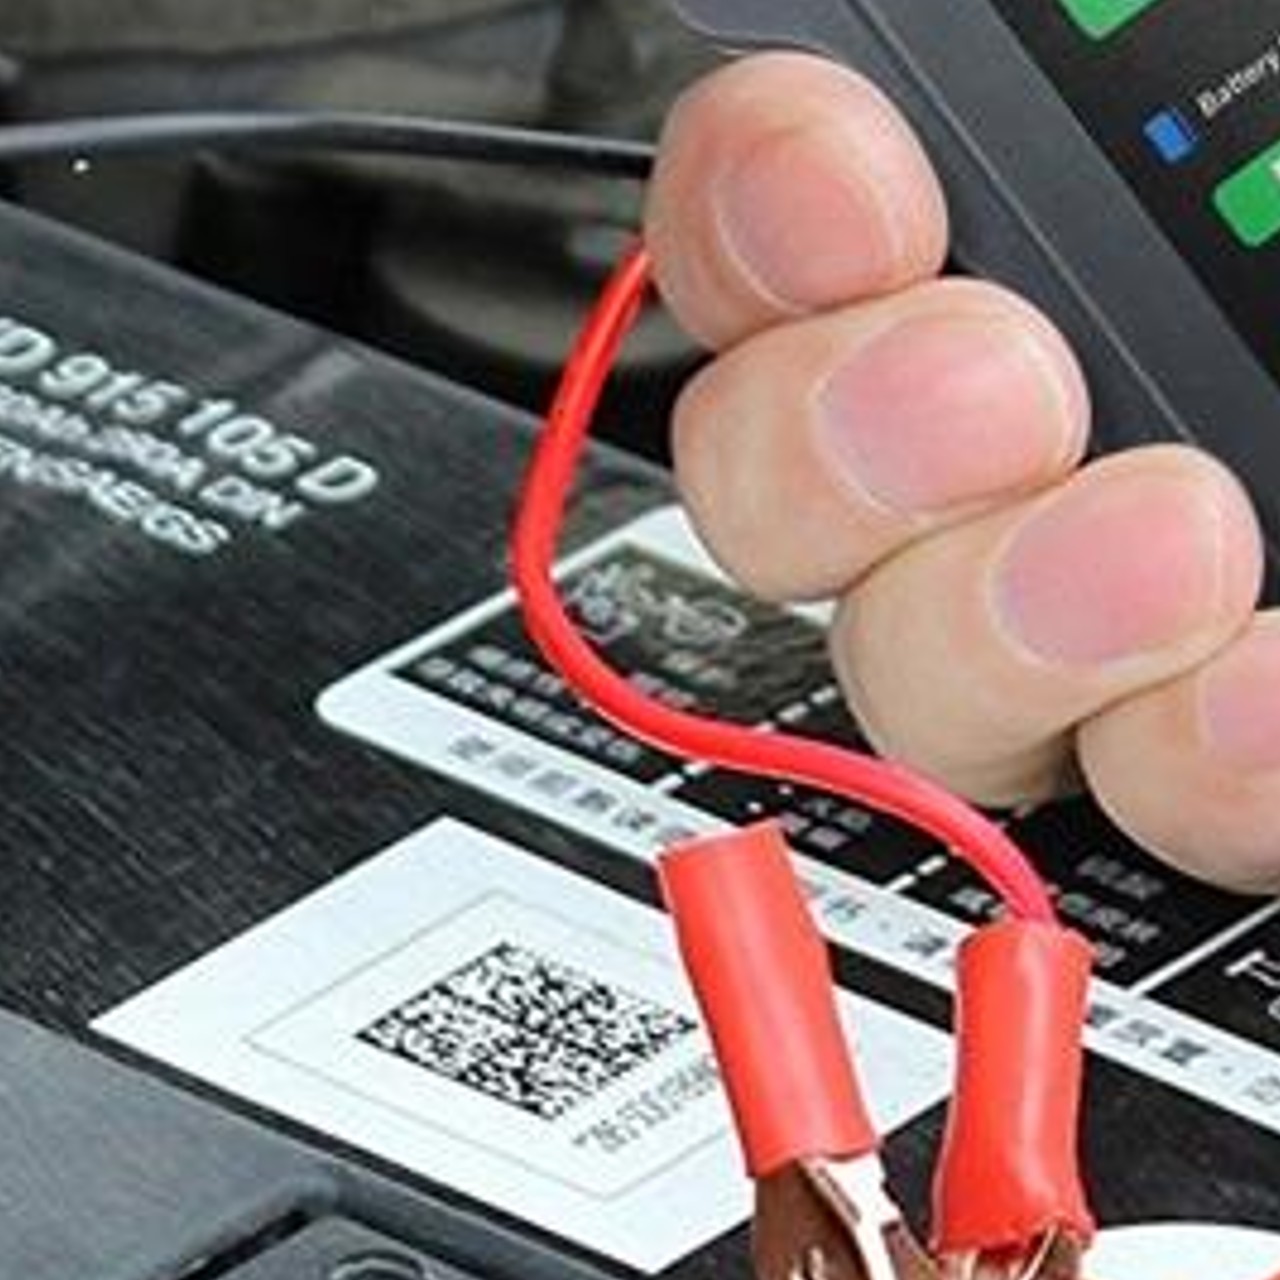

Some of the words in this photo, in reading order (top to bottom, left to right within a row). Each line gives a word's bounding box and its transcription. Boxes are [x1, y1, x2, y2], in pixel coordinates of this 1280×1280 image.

[38, 352, 188, 422] 915
[177, 397, 317, 478] 105
[294, 454, 380, 504] D
